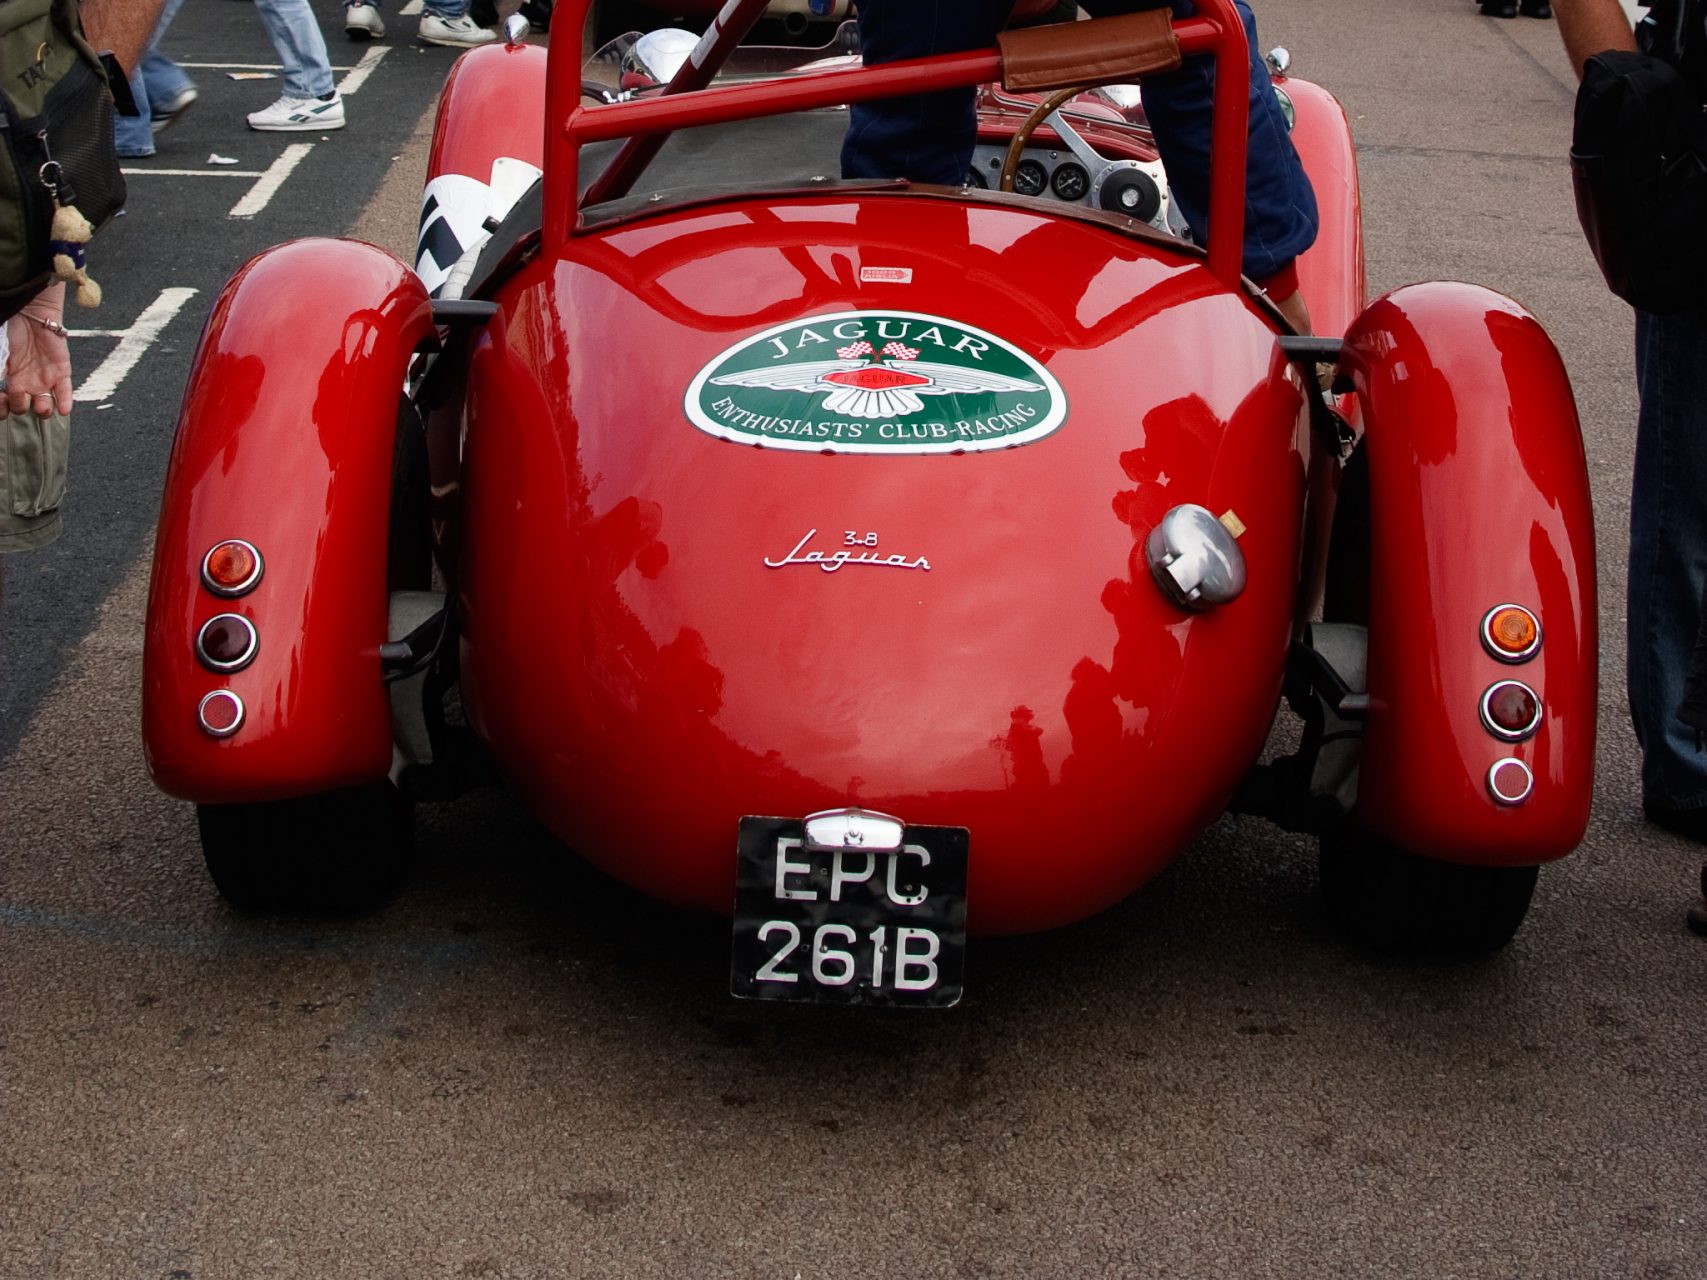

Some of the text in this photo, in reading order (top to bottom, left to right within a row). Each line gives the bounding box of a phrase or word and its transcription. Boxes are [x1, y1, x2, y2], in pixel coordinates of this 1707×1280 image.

[767, 320, 990, 360] JAGUAR
[764, 529, 932, 571] Jaguar
[775, 837, 931, 906] EPC
[756, 920, 940, 991] 261B
